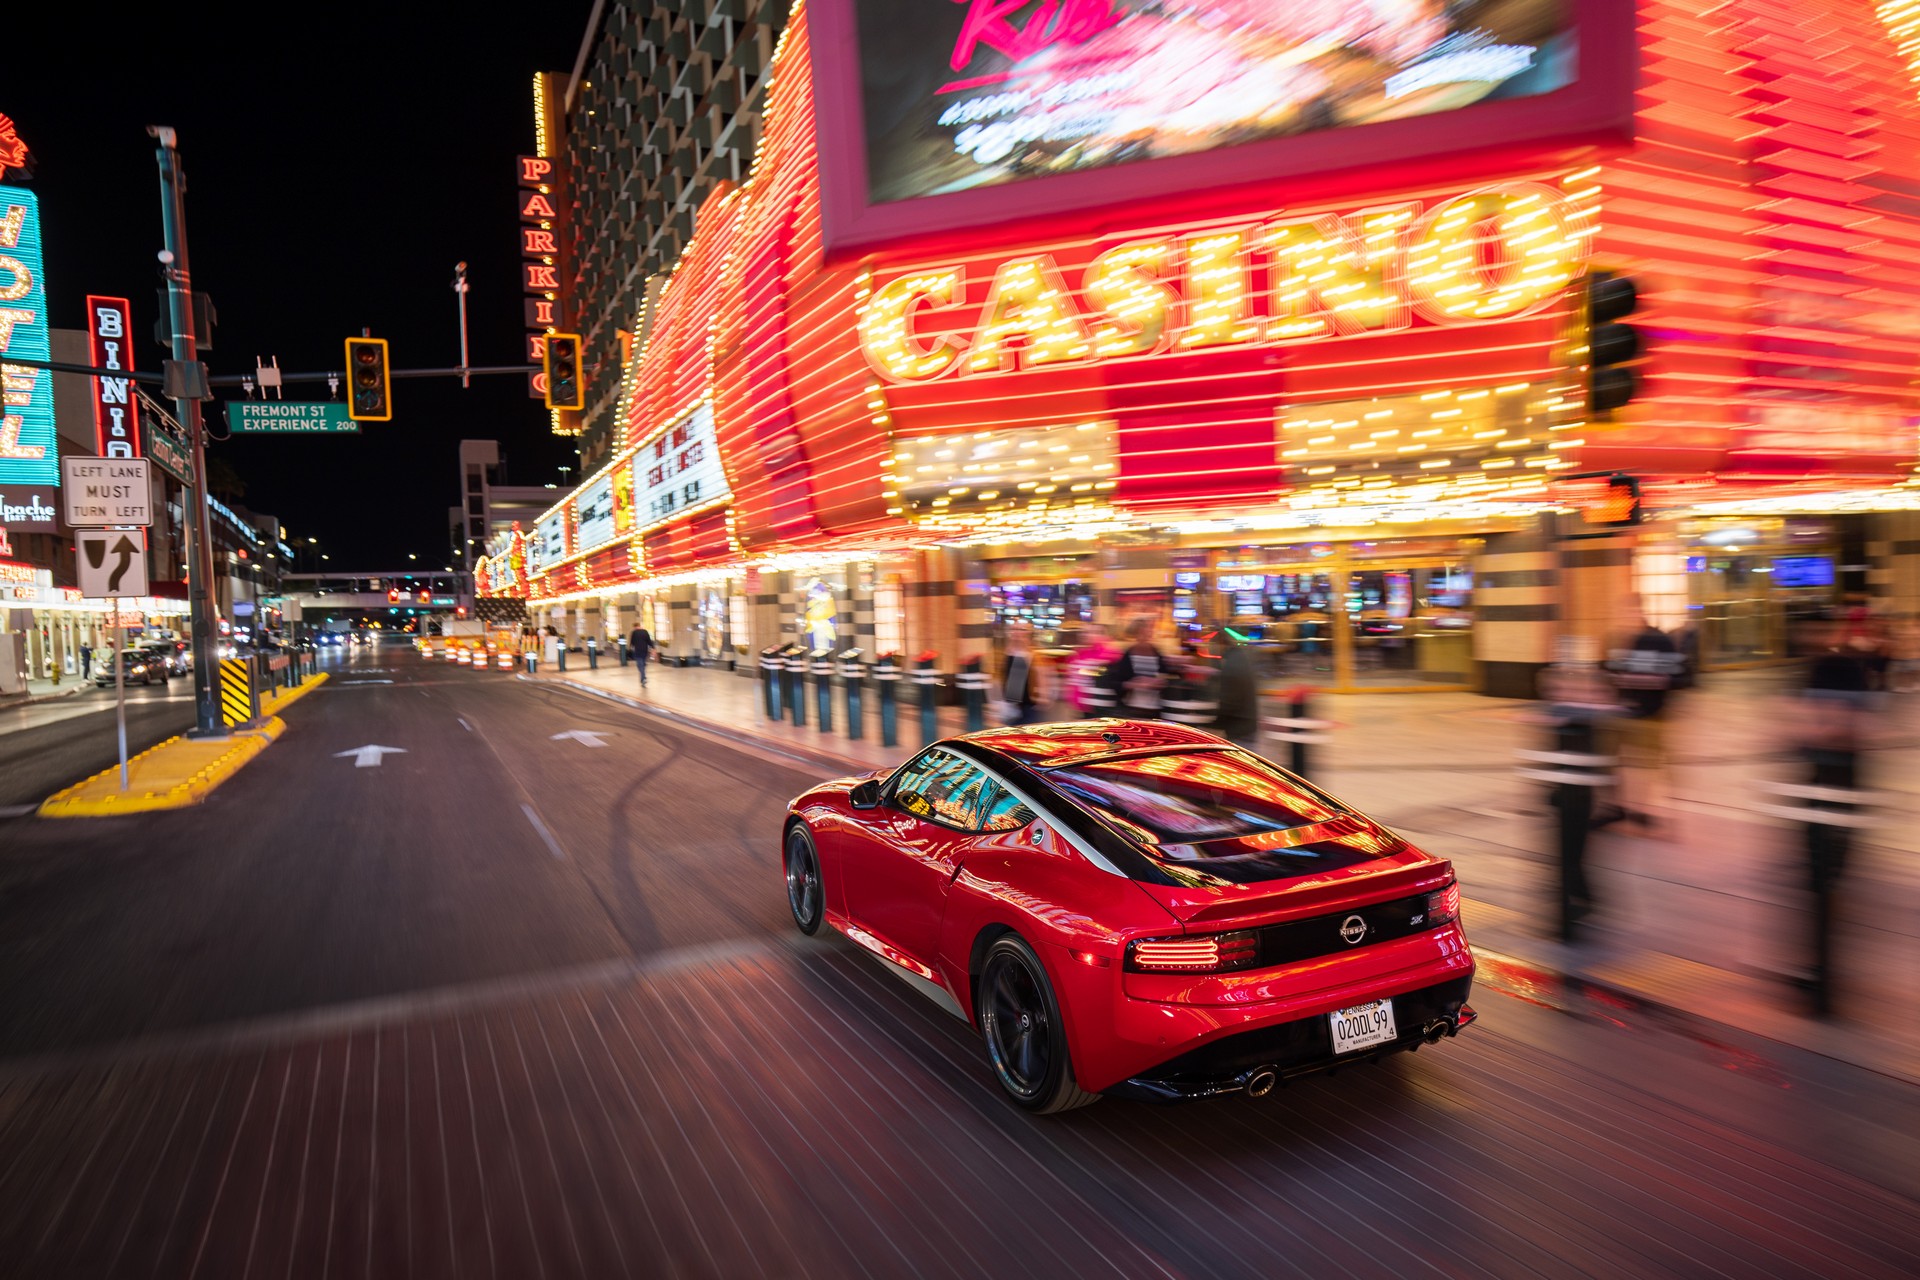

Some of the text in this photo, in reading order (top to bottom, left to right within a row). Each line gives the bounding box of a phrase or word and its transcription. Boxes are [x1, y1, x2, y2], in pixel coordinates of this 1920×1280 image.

[860, 180, 1592, 385] CASINO
[242, 405, 325, 417] FREMONT ST
[243, 419, 357, 431] EXPERIENCE 200
[72, 466, 143, 478] LEFT LANE
[86, 485, 131, 498] MUST
[73, 506, 145, 517] TURN LEFT
[1340, 924, 1367, 936] NISSAN
[1345, 1002, 1378, 1015] TENNESSEE
[1337, 1009, 1388, 1040] 020DL99
[1352, 1034, 1381, 1045] MANUFACTURER
